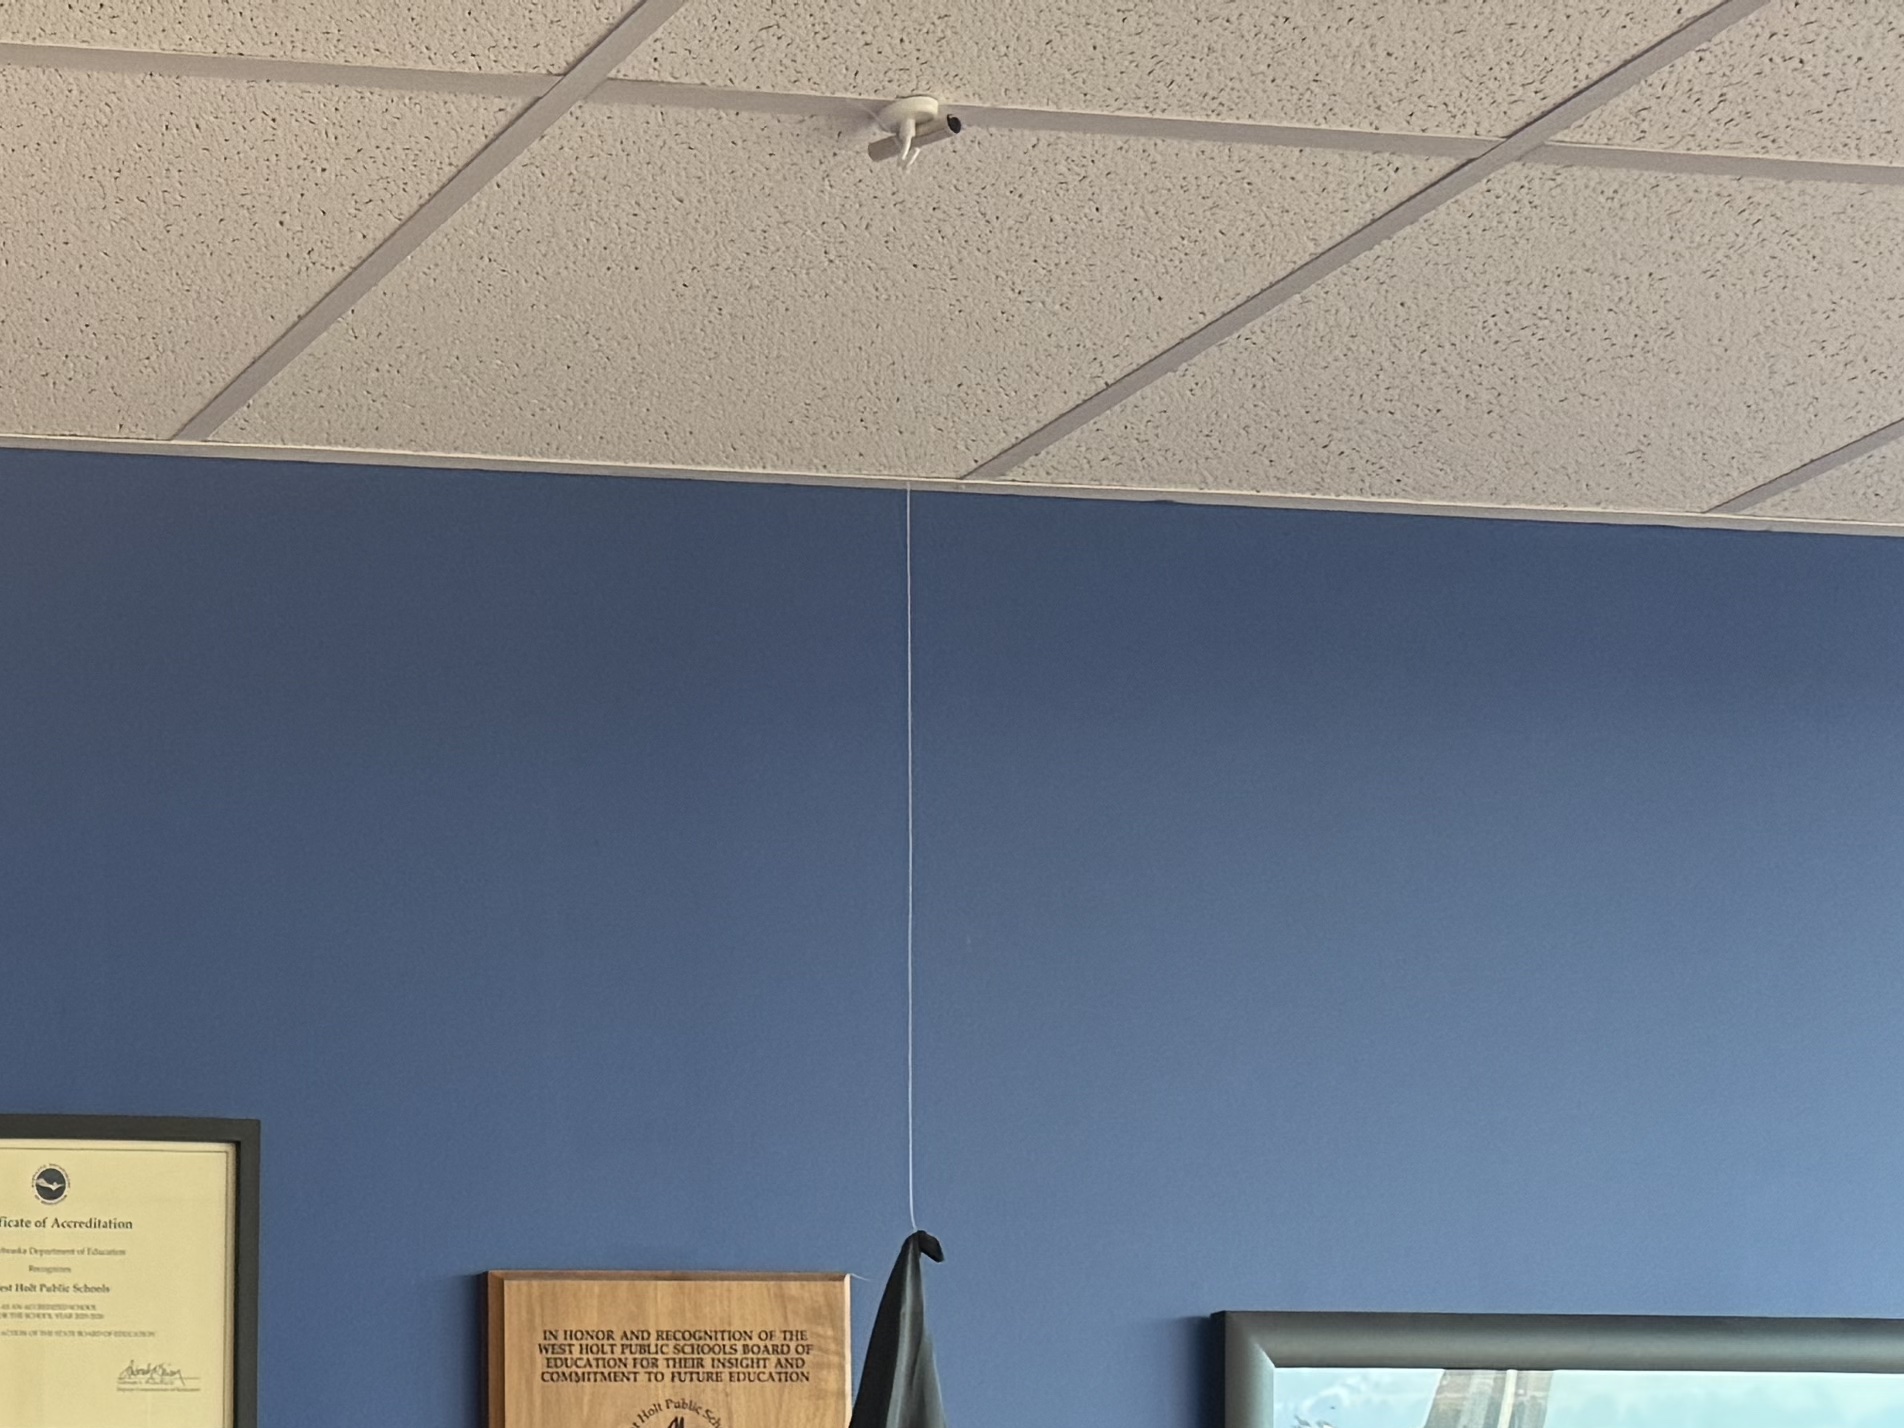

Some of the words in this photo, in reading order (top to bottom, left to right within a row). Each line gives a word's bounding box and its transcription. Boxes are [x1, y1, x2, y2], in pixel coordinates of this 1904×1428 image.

[34, 1217, 47, 1229] of
[51, 1217, 133, 1230] Accreditation
[39, 1283, 70, 1293] Public
[73, 1284, 110, 1294] Schools
[543, 1329, 559, 1341] IN
[563, 1329, 615, 1341] HONOR
[620, 1329, 650, 1341] AND
[656, 1329, 753, 1341] RECOGNITION
[758, 1329, 776, 1341] OF
[781, 1329, 808, 1341] THE
[537, 1343, 575, 1355] WEST
[579, 1343, 617, 1355] HOLT
[620, 1343, 669, 1355] PUBLIC
[673, 1343, 738, 1355] SCHOOLS
[742, 1343, 791, 1355] BOARD
[795, 1343, 814, 1355] OF
[546, 1357, 628, 1369] EDUCATION
[632, 1357, 660, 1369] FOR
[664, 1357, 705, 1369] THEIR
[711, 1357, 769, 1369] INSIGHT
[774, 1357, 805, 1369] AND
[541, 1371, 641, 1383] COMMITMENT
[645, 1371, 665, 1383] TO
[670, 1371, 723, 1383] FUTURE
[728, 1371, 810, 1383] EDUCATION
[640, 1402, 663, 1424] Holt
[664, 1398, 703, 1416] Public
